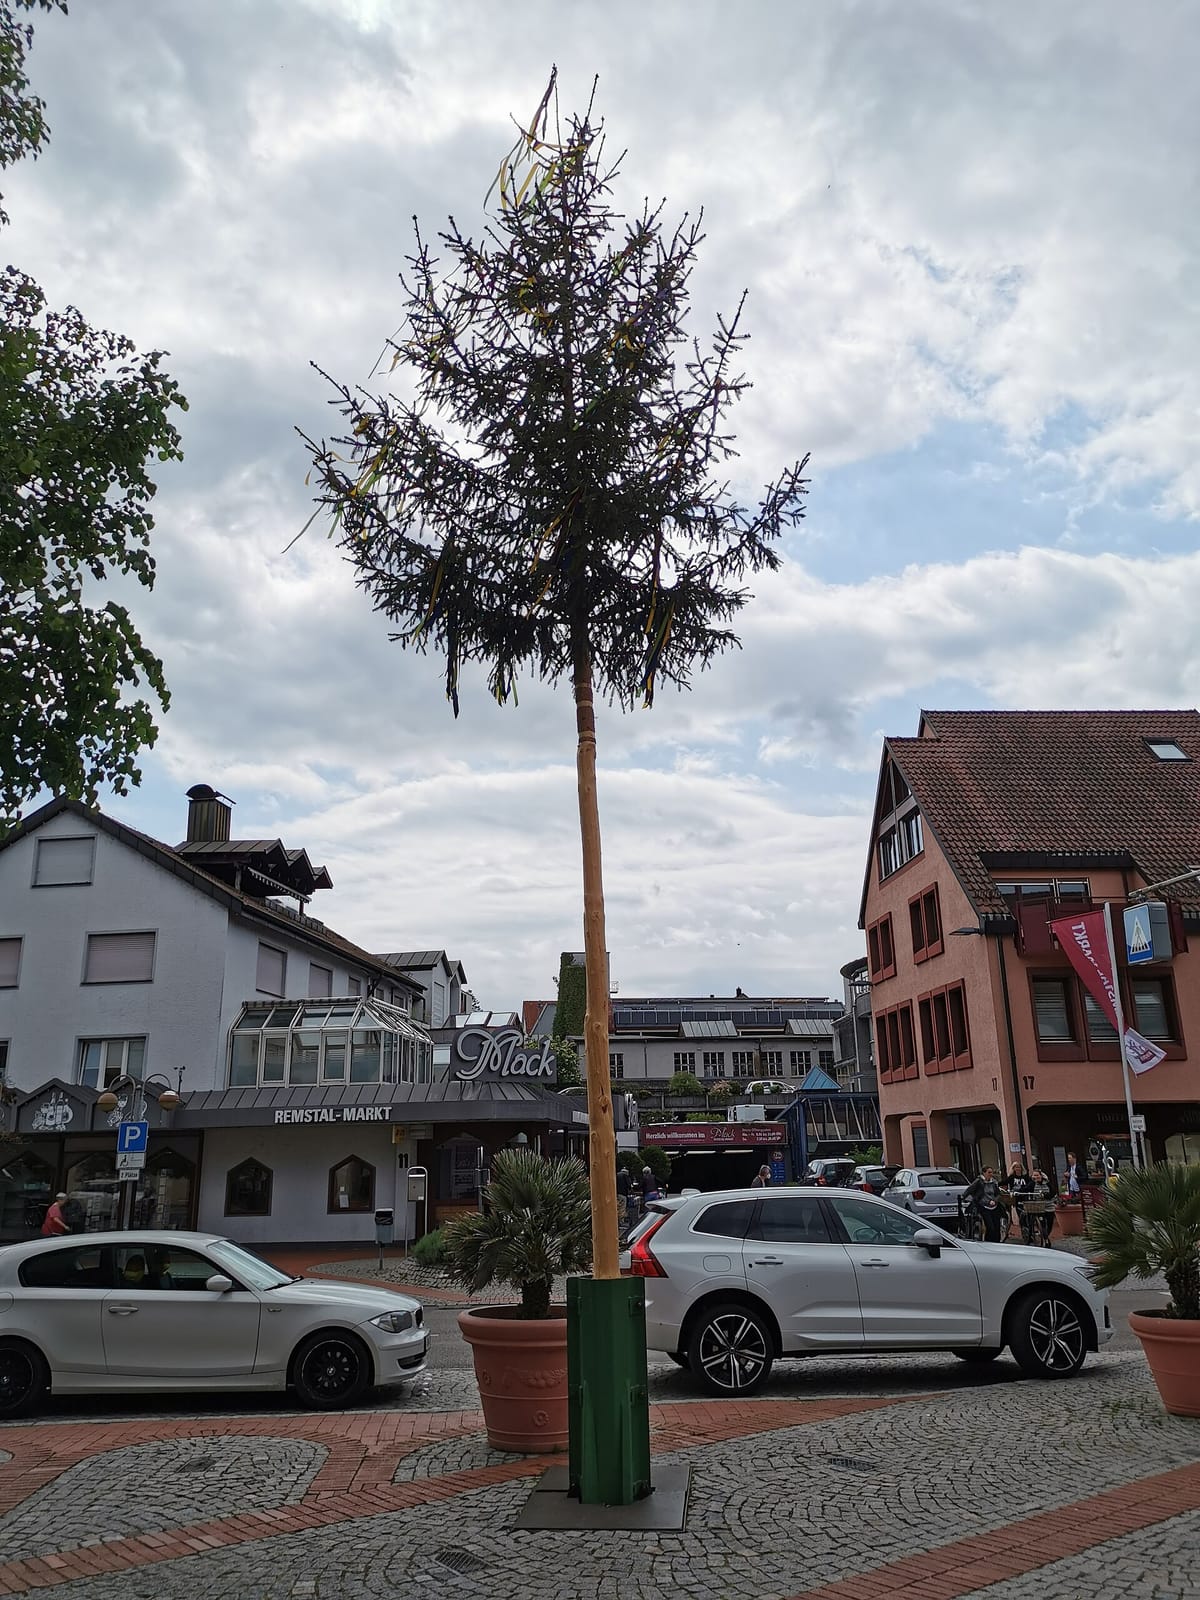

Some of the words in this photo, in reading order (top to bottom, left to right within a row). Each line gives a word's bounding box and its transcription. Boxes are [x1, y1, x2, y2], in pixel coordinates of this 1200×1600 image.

[455, 1028, 555, 1080] Mack
[1022, 1075, 1035, 1090] 17
[274, 1106, 392, 1124] REMSTAL-MARKT
[124, 1125, 141, 1149] P
[398, 1153, 409, 1168] 11
